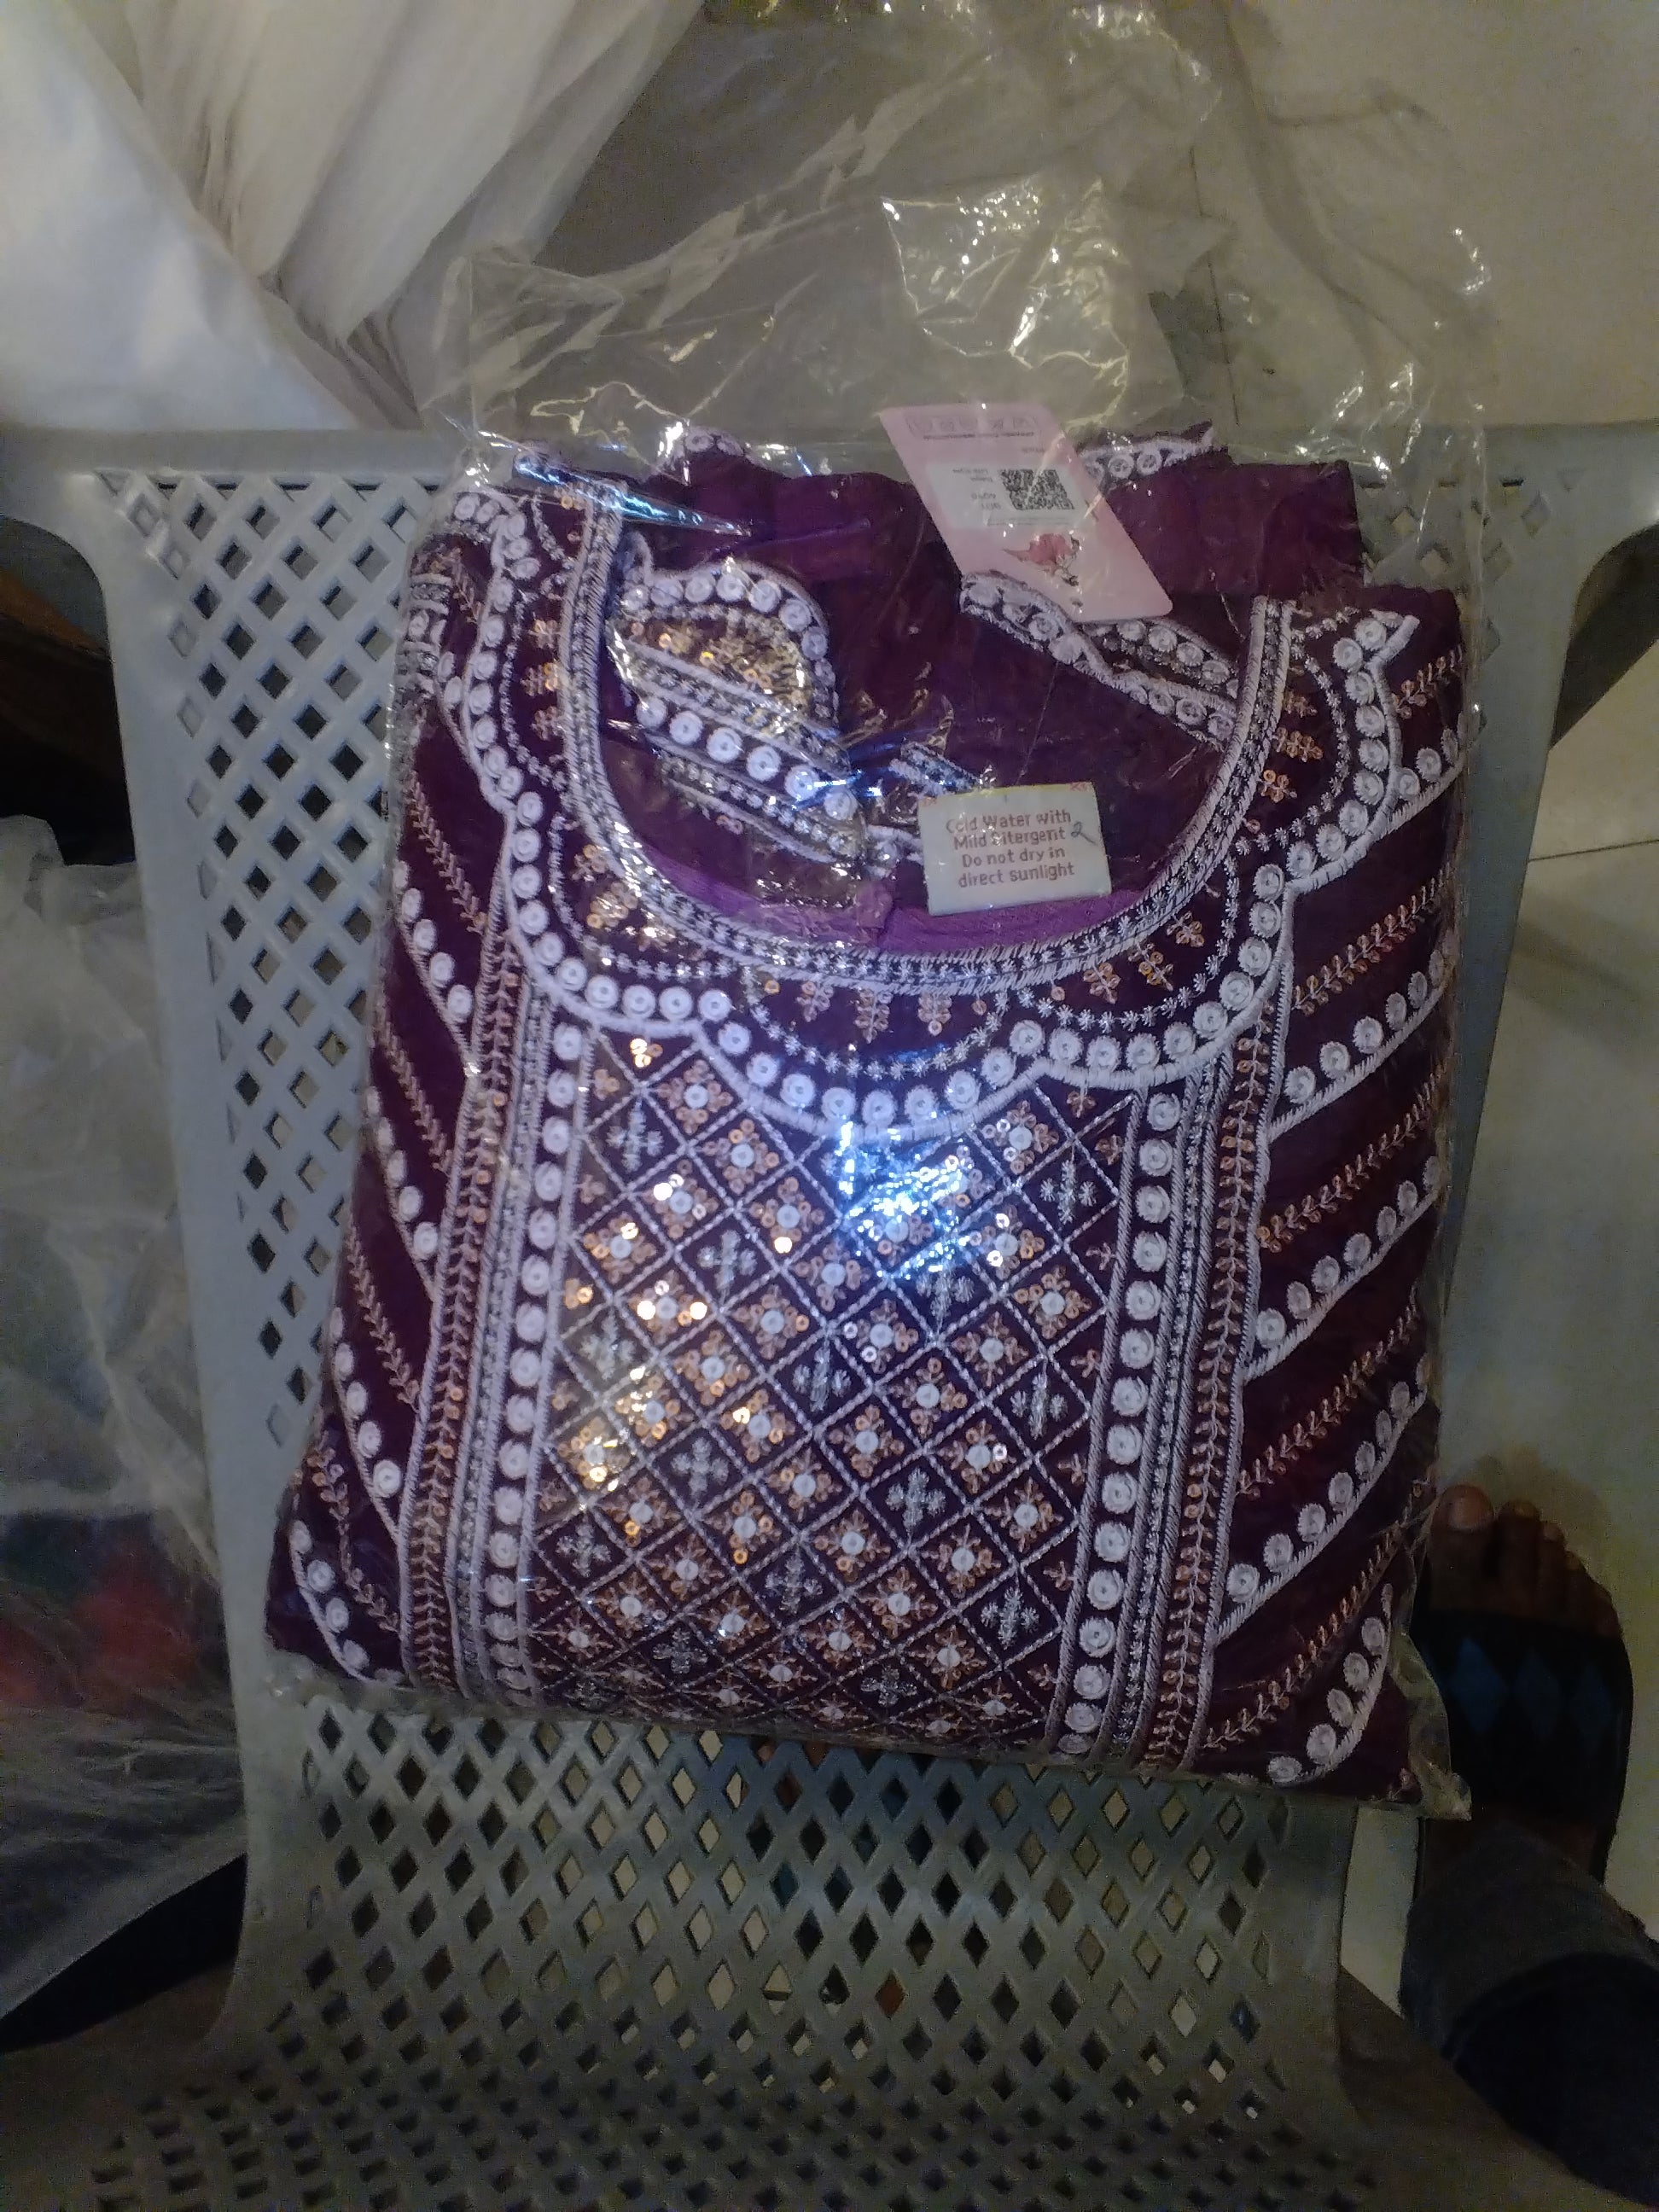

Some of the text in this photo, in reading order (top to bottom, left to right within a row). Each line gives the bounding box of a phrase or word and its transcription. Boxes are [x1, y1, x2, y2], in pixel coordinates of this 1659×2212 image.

[982, 813, 1031, 829] Water
[1036, 808, 1071, 825] with
[953, 830, 987, 850] Mild
[962, 846, 1066, 869] Do not dry in
[958, 861, 1075, 888] direct sunlight
